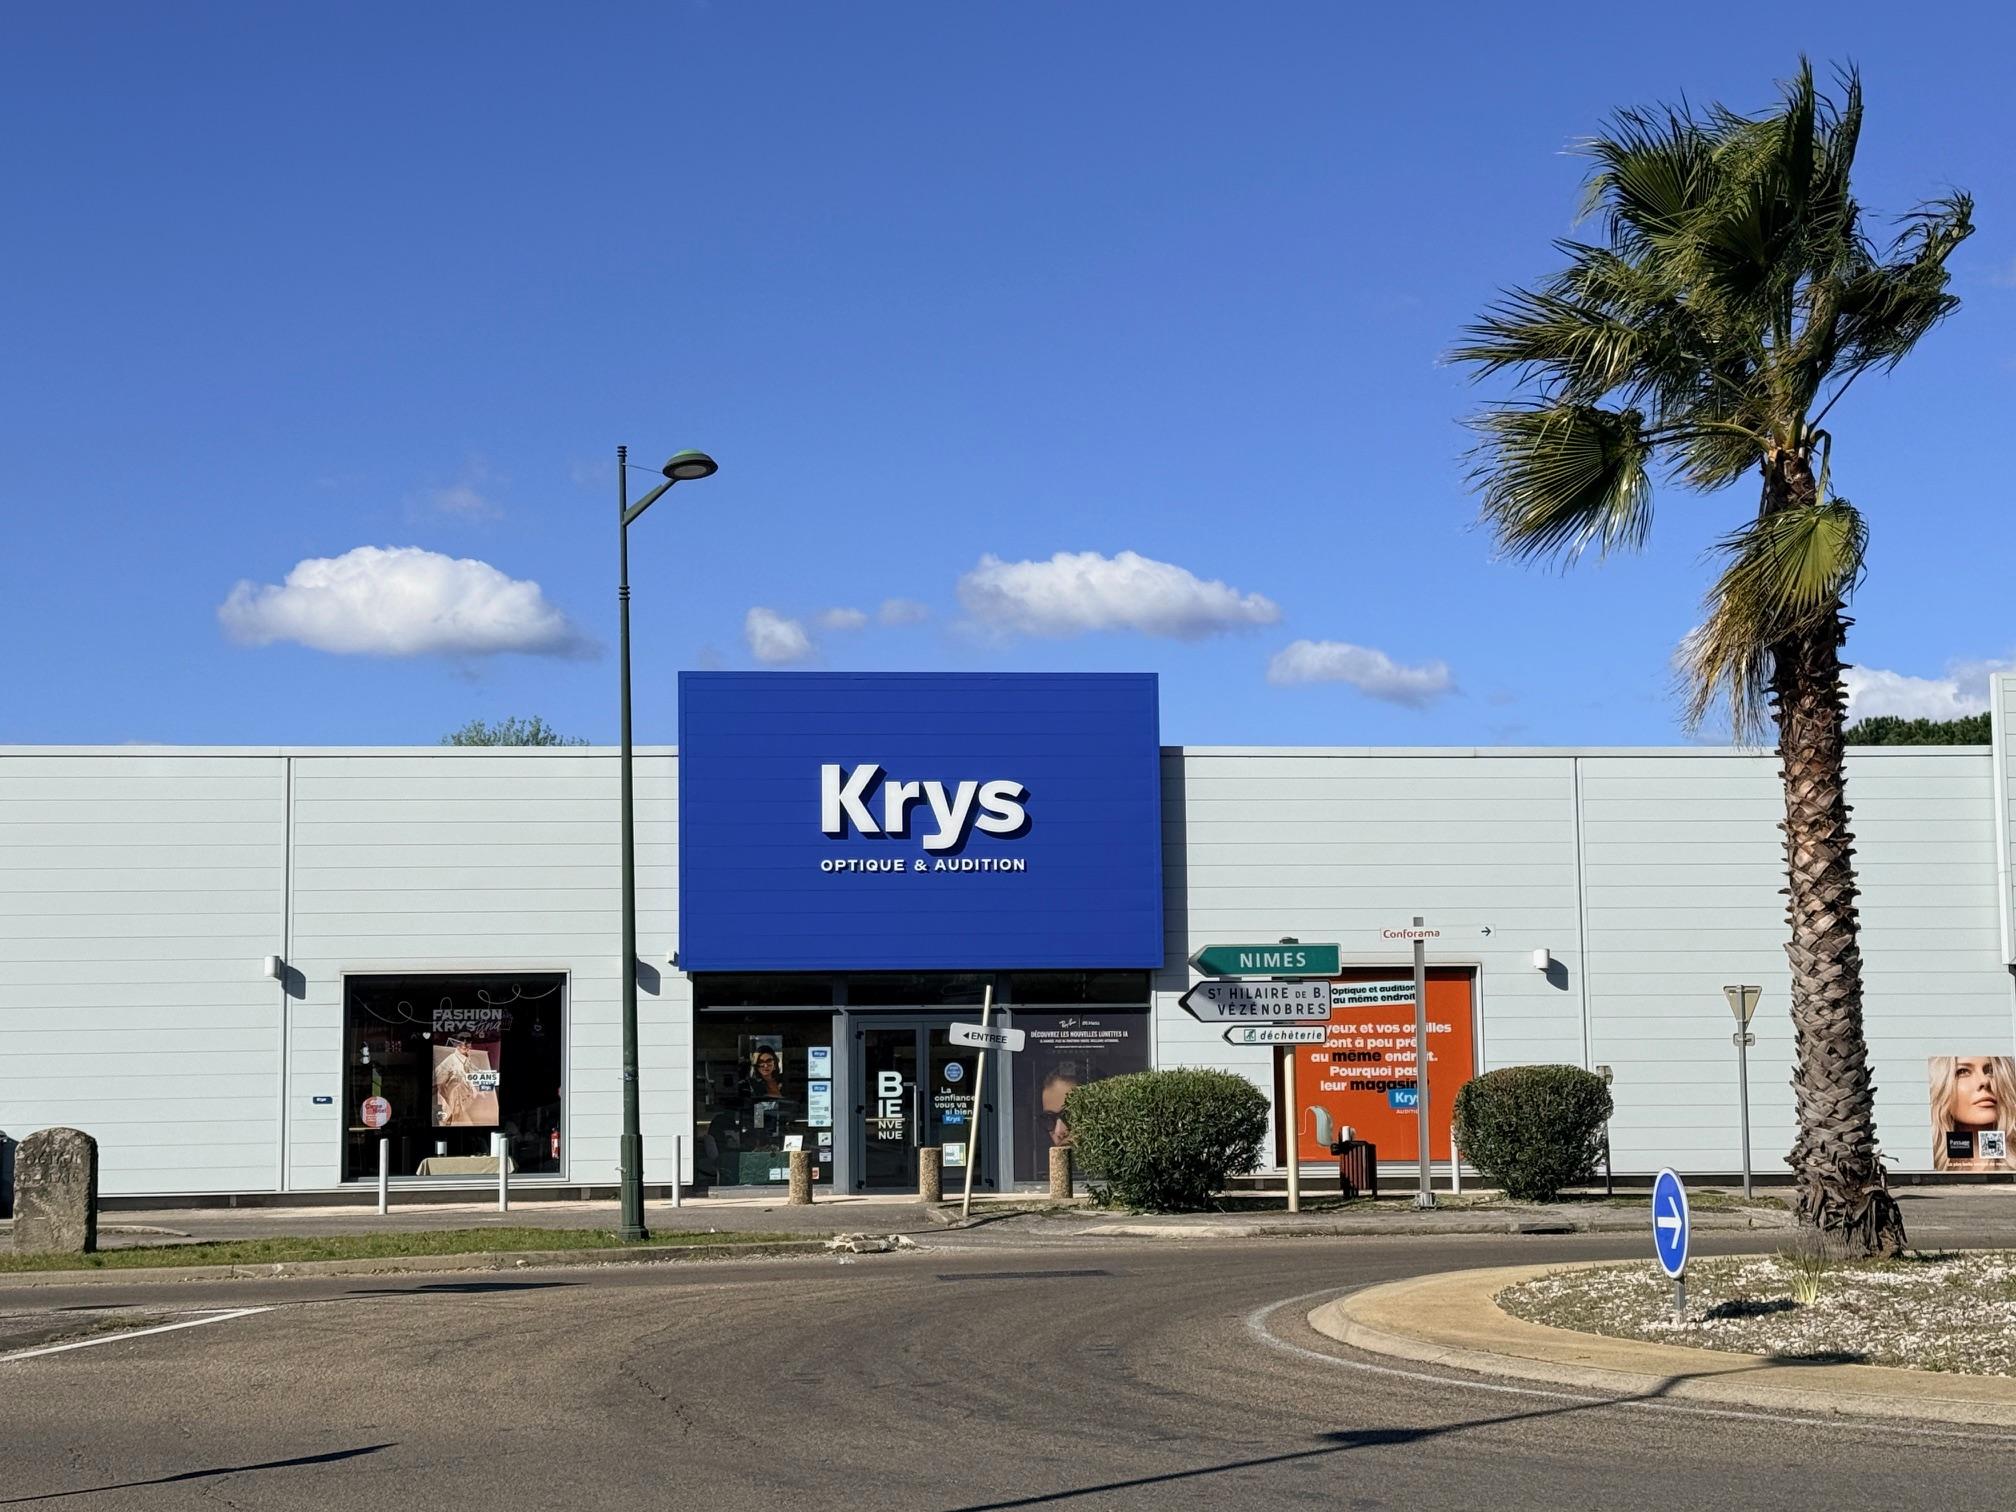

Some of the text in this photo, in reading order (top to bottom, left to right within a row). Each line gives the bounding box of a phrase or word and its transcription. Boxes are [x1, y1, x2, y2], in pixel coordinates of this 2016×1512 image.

[821, 764, 1026, 850] Krys
[820, 859, 1026, 872] OPTIQUE & AUDITION
[1383, 929, 1440, 939] Conforama
[1240, 952, 1307, 968] NIMES
[1229, 987, 1289, 999] HILAIRE
[1295, 990, 1307, 999] DE
[1313, 987, 1326, 999] B.
[1331, 984, 1416, 996] Optique et audition
[1332, 996, 1346, 1004] au
[1347, 993, 1379, 1004] même
[432, 1009, 503, 1020] FASHION
[1217, 1002, 1327, 1016] VÉZÉNOBRES
[1030, 1029, 1060, 1038] DÉCOUVREZ
[1060, 1030, 1070, 1038] LES
[1070, 1030, 1097, 1038] NOUVELLES
[1098, 1030, 1122, 1038] LUNETTES
[1359, 1022, 1374, 1034] et
[1376, 1024, 1401, 1034] vos
[1402, 1022, 1452, 1034] orilles
[1260, 1029, 1322, 1041] déchèterie
[1354, 1036, 1365, 1048] à
[1367, 1038, 1393, 1050] peu
[1395, 1037, 1418, 1050] prè
[1310, 1053, 1329, 1063] au
[1332, 1049, 1382, 1062] même
[1329, 1065, 1417, 1079] Pourquoi pas
[878, 1071, 904, 1098] B
[940, 1086, 952, 1094] La
[1320, 1080, 1347, 1092] leur
[934, 1093, 976, 1102] confiance
[1395, 1092, 1419, 1106] Kry
[878, 1099, 903, 1118] IE
[953, 1108, 973, 1116] bien
[878, 1120, 903, 1129] NVE
[945, 1116, 961, 1124] Krys
[878, 1130, 903, 1140] NUE
